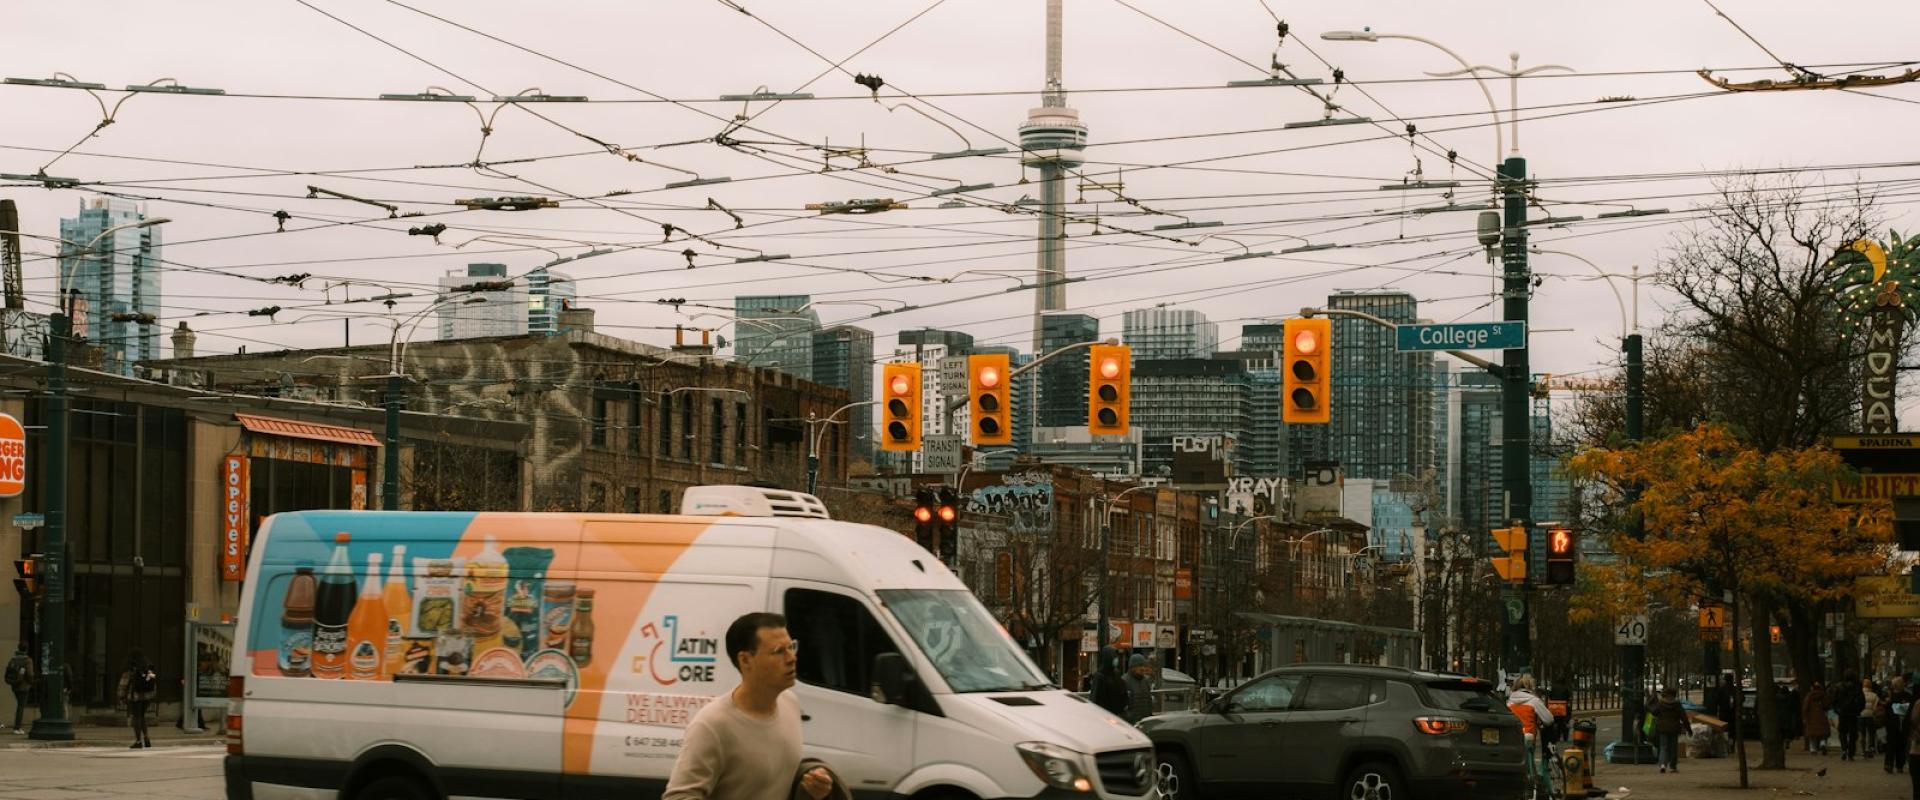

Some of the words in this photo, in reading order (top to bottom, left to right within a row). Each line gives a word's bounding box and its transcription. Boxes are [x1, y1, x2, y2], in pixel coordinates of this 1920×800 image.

[1420, 327, 1488, 348] College
[1492, 325, 1502, 335] St
[943, 362, 963, 370] LEFT
[943, 372, 965, 380] TURN
[1867, 328, 1895, 433] MOCA
[942, 383, 967, 391] SIGNAL
[926, 440, 958, 453] TRANSIT
[1858, 437, 1913, 447] SPADINA
[928, 455, 957, 468] SIGNAL
[1226, 477, 1280, 504] XRAY
[1619, 620, 1645, 639] 40
[626, 694, 650, 707] WE
[626, 708, 689, 723] DELIVER
